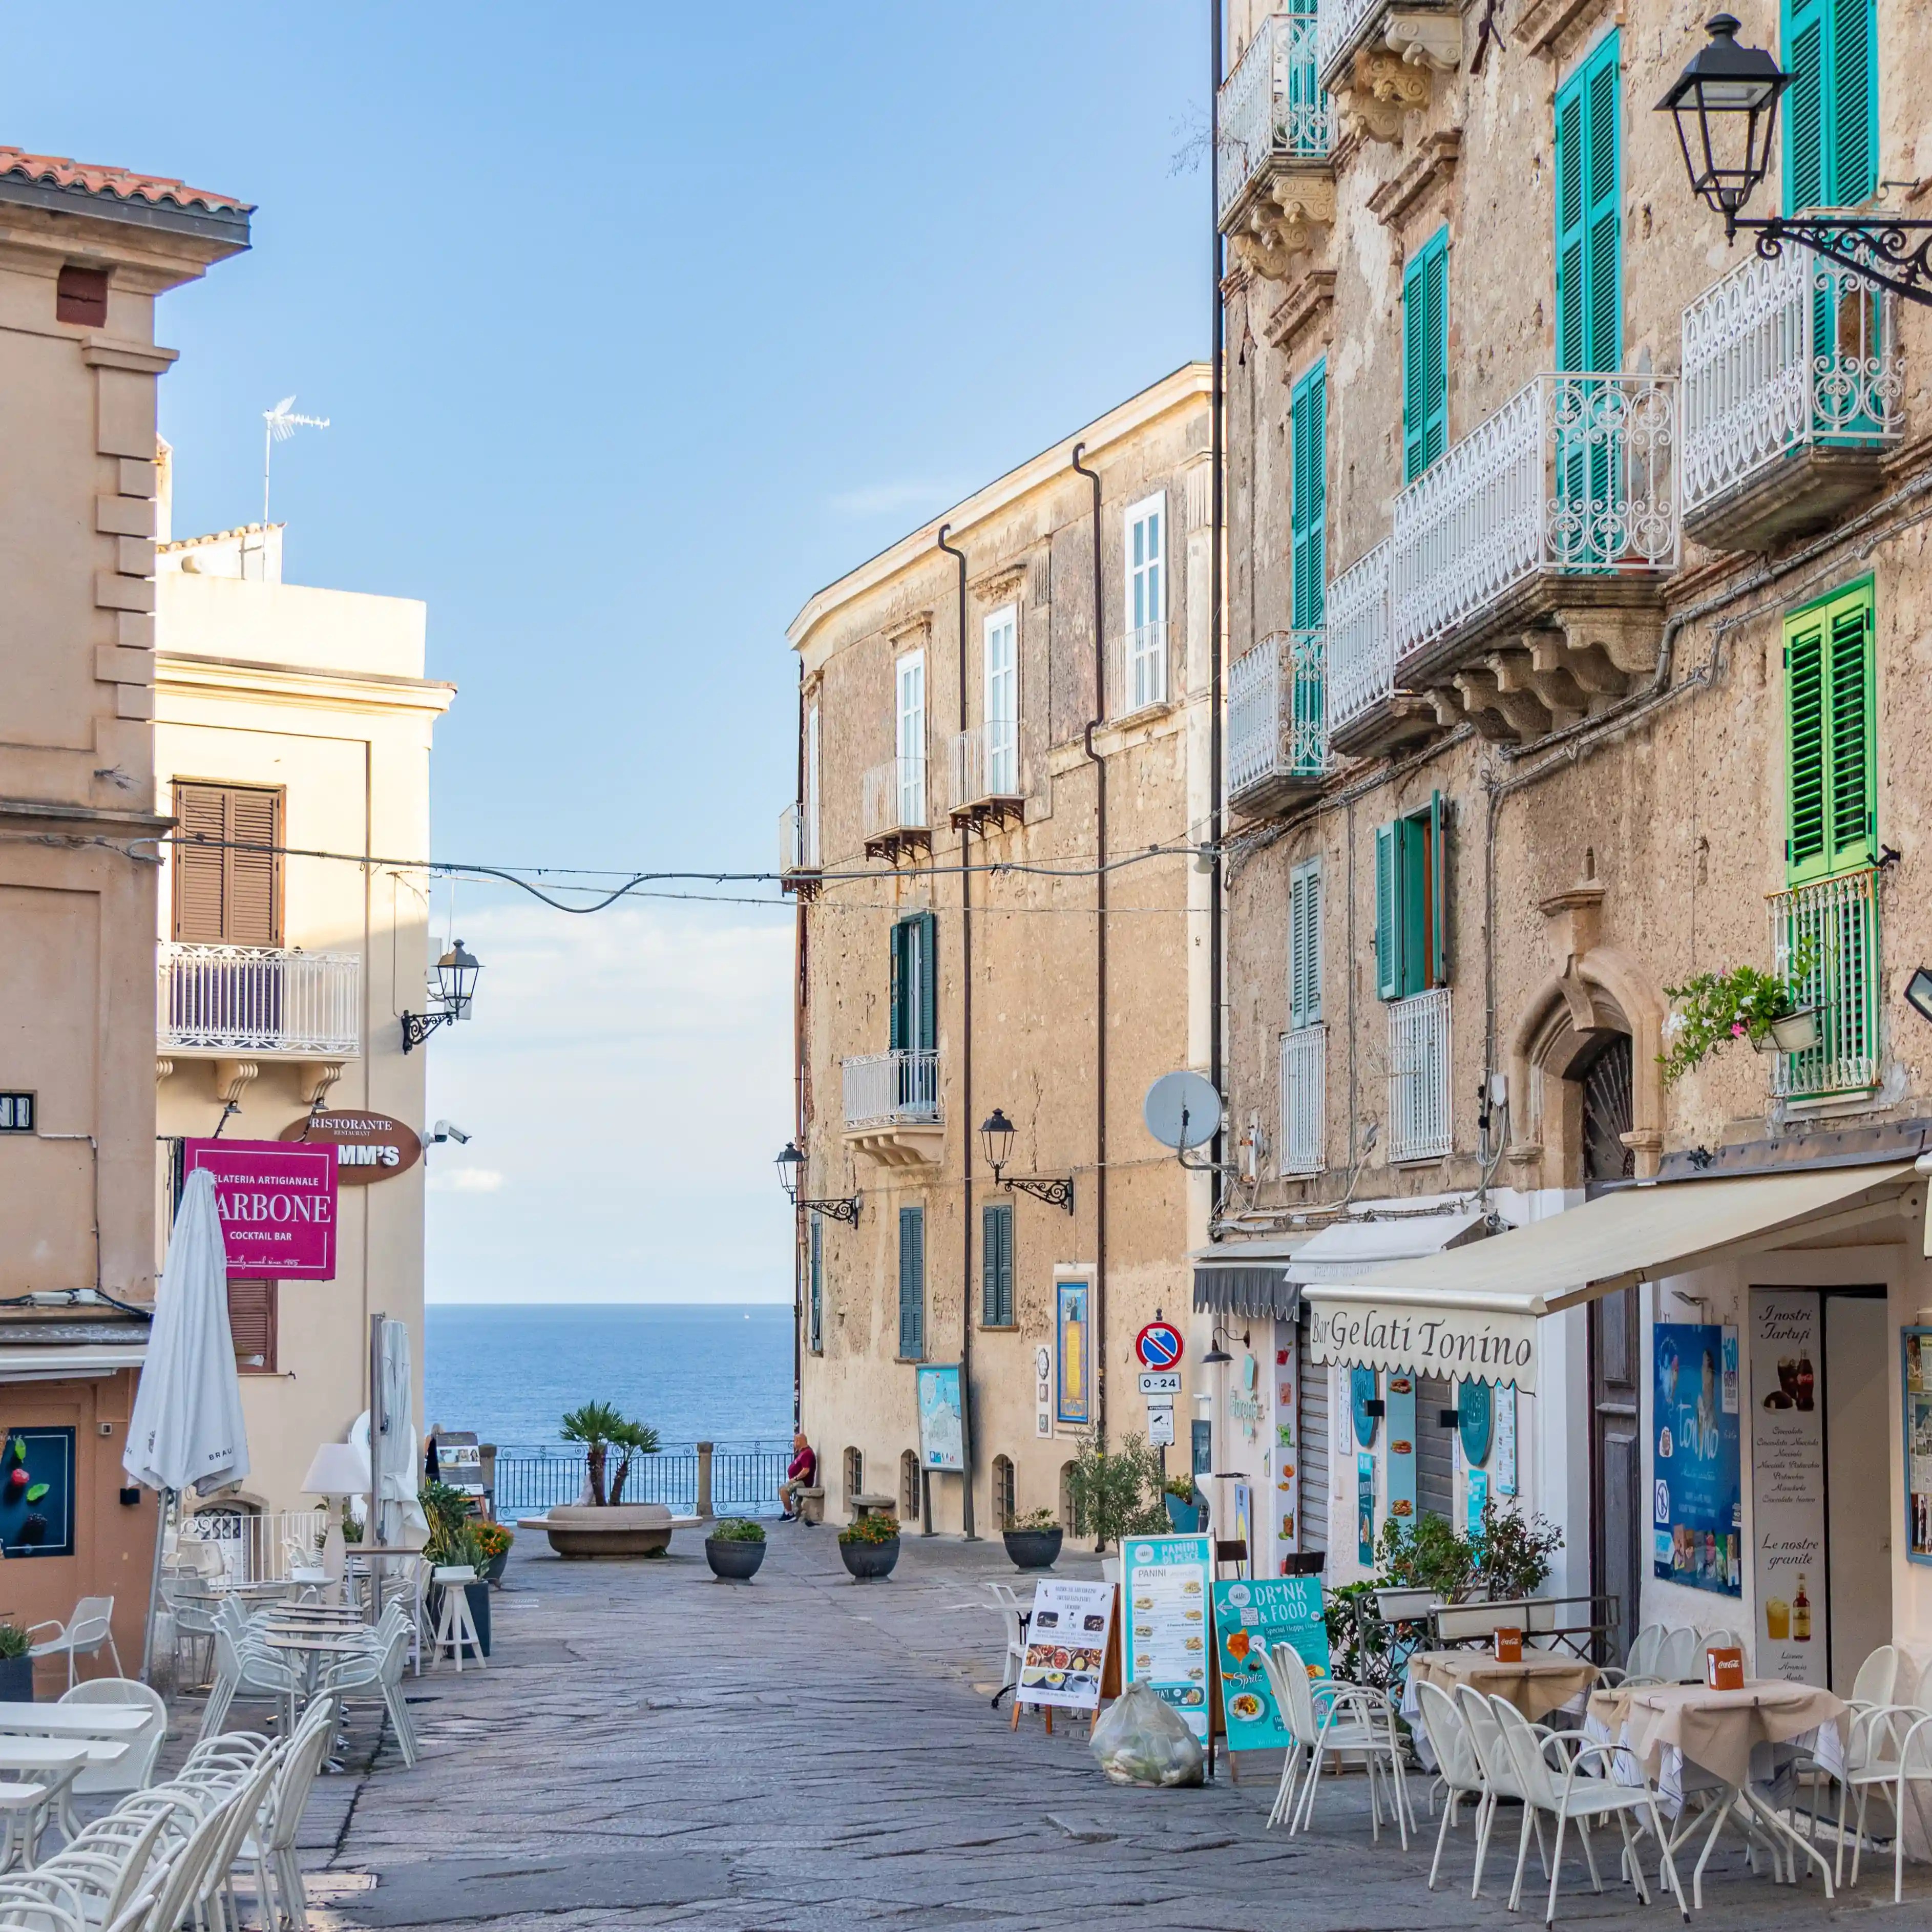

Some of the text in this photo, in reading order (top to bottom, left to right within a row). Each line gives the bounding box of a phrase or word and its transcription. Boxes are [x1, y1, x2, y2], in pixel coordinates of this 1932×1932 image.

[311, 1118, 392, 1131] RISTORANTE
[338, 1145, 400, 1166] MM'S
[214, 1174, 319, 1186] ELATERIA ARTIGIANALE
[216, 1193, 331, 1223] ARBONE
[230, 1231, 292, 1241] COCKTAIL BAR
[1774, 1309, 1813, 1321] nostri
[1312, 1310, 1531, 1366] Bar Gelati Tonino
[1760, 1322, 1811, 1345] Tartufi
[1160, 1378, 1177, 1388] 24
[209, 1446, 234, 1460] BRAU
[1161, 1541, 1199, 1556] PANINI
[1762, 1534, 1819, 1550] Le nostre
[1768, 1552, 1813, 1570] granite
[1139, 1569, 1166, 1578] PANINI
[1260, 1611, 1268, 1624] &
[1271, 1601, 1307, 1623] FOOD
[1266, 1625, 1286, 1636] Special
[1229, 1671, 1264, 1690] Spritz
